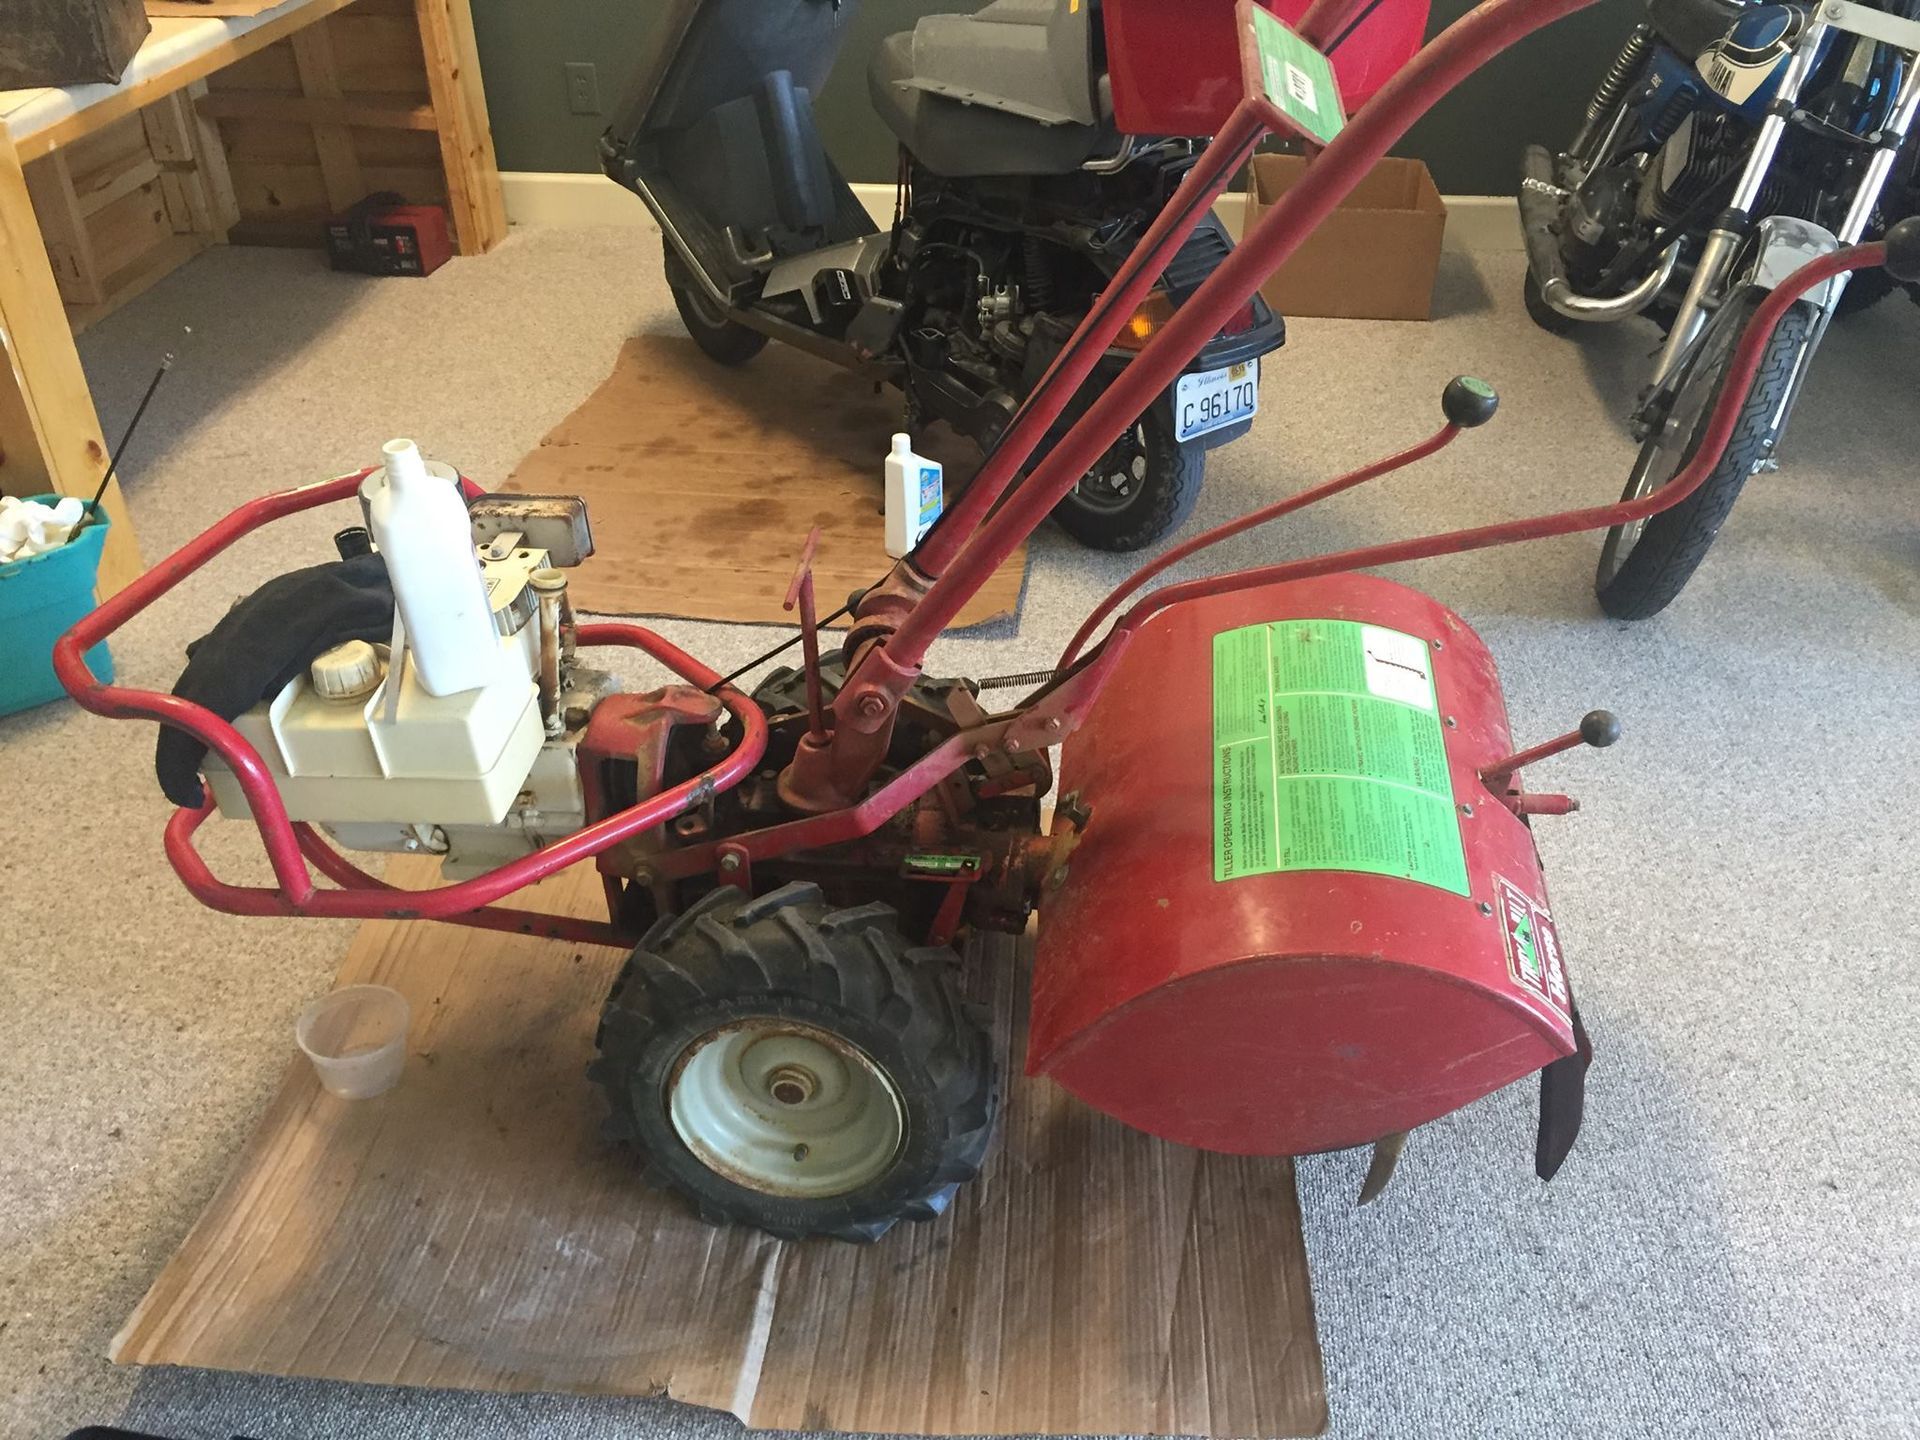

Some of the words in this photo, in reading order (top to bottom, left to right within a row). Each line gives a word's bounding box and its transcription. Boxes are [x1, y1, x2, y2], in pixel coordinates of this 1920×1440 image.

[1184, 403, 1194, 429] C
[1200, 381, 1254, 423] 96170
[1222, 747, 1232, 802] INSTRUCTIONS
[1223, 803, 1232, 849] OPERATING
[1224, 850, 1233, 878] TILLER
